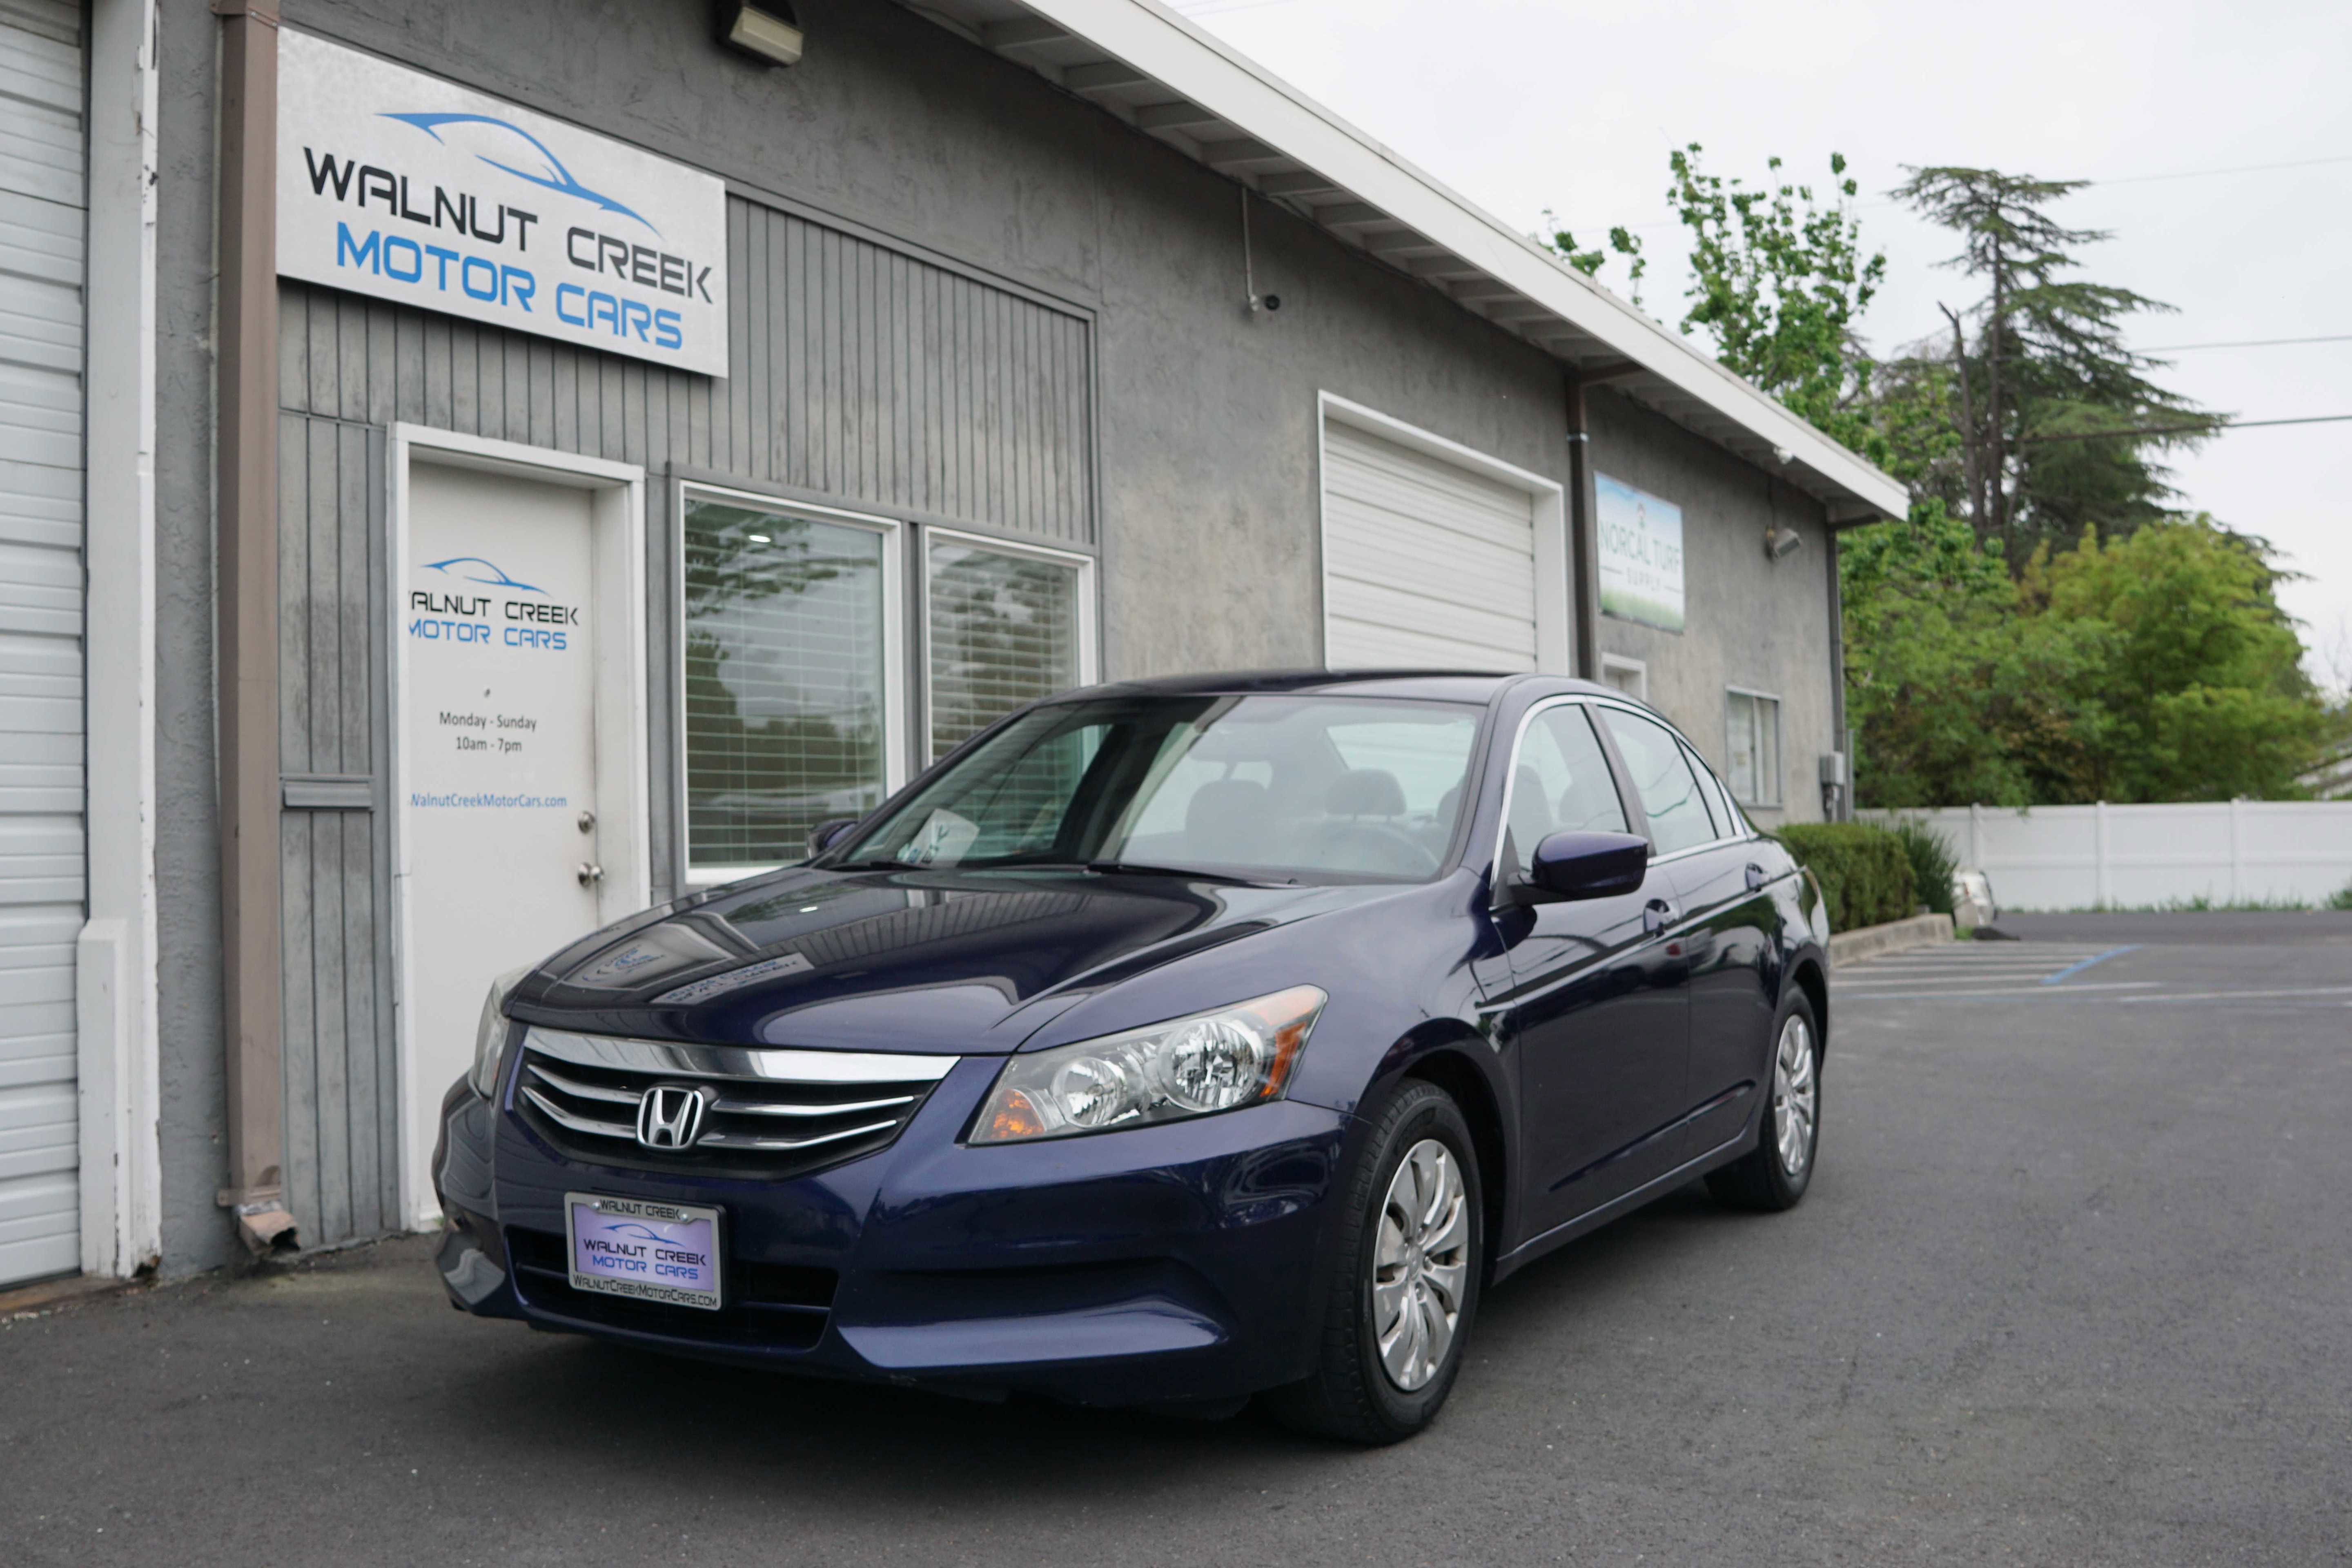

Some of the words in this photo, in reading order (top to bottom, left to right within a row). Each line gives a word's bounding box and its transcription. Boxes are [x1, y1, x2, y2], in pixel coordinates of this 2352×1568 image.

[303, 146, 538, 252] WALNUT
[567, 226, 713, 304] CREEK
[336, 221, 535, 313] MOTOR
[556, 283, 683, 350] CARS
[1599, 520, 1651, 566] NORCAL
[1652, 538, 1680, 572] TURF
[410, 590, 492, 617] ALNUT
[505, 601, 579, 626] CREEK
[504, 627, 567, 650] CARS
[439, 711, 487, 730] Monday
[497, 714, 537, 732] Sunday
[456, 736, 487, 751] 10am
[497, 737, 522, 754] 7pm
[600, 1199, 642, 1216] WALNUT
[646, 1205, 681, 1220] CREEK
[584, 1239, 647, 1257] WALNUT
[655, 1248, 706, 1266] CREEK
[592, 1254, 647, 1272] MOTOR
[655, 1264, 699, 1280] CARS
